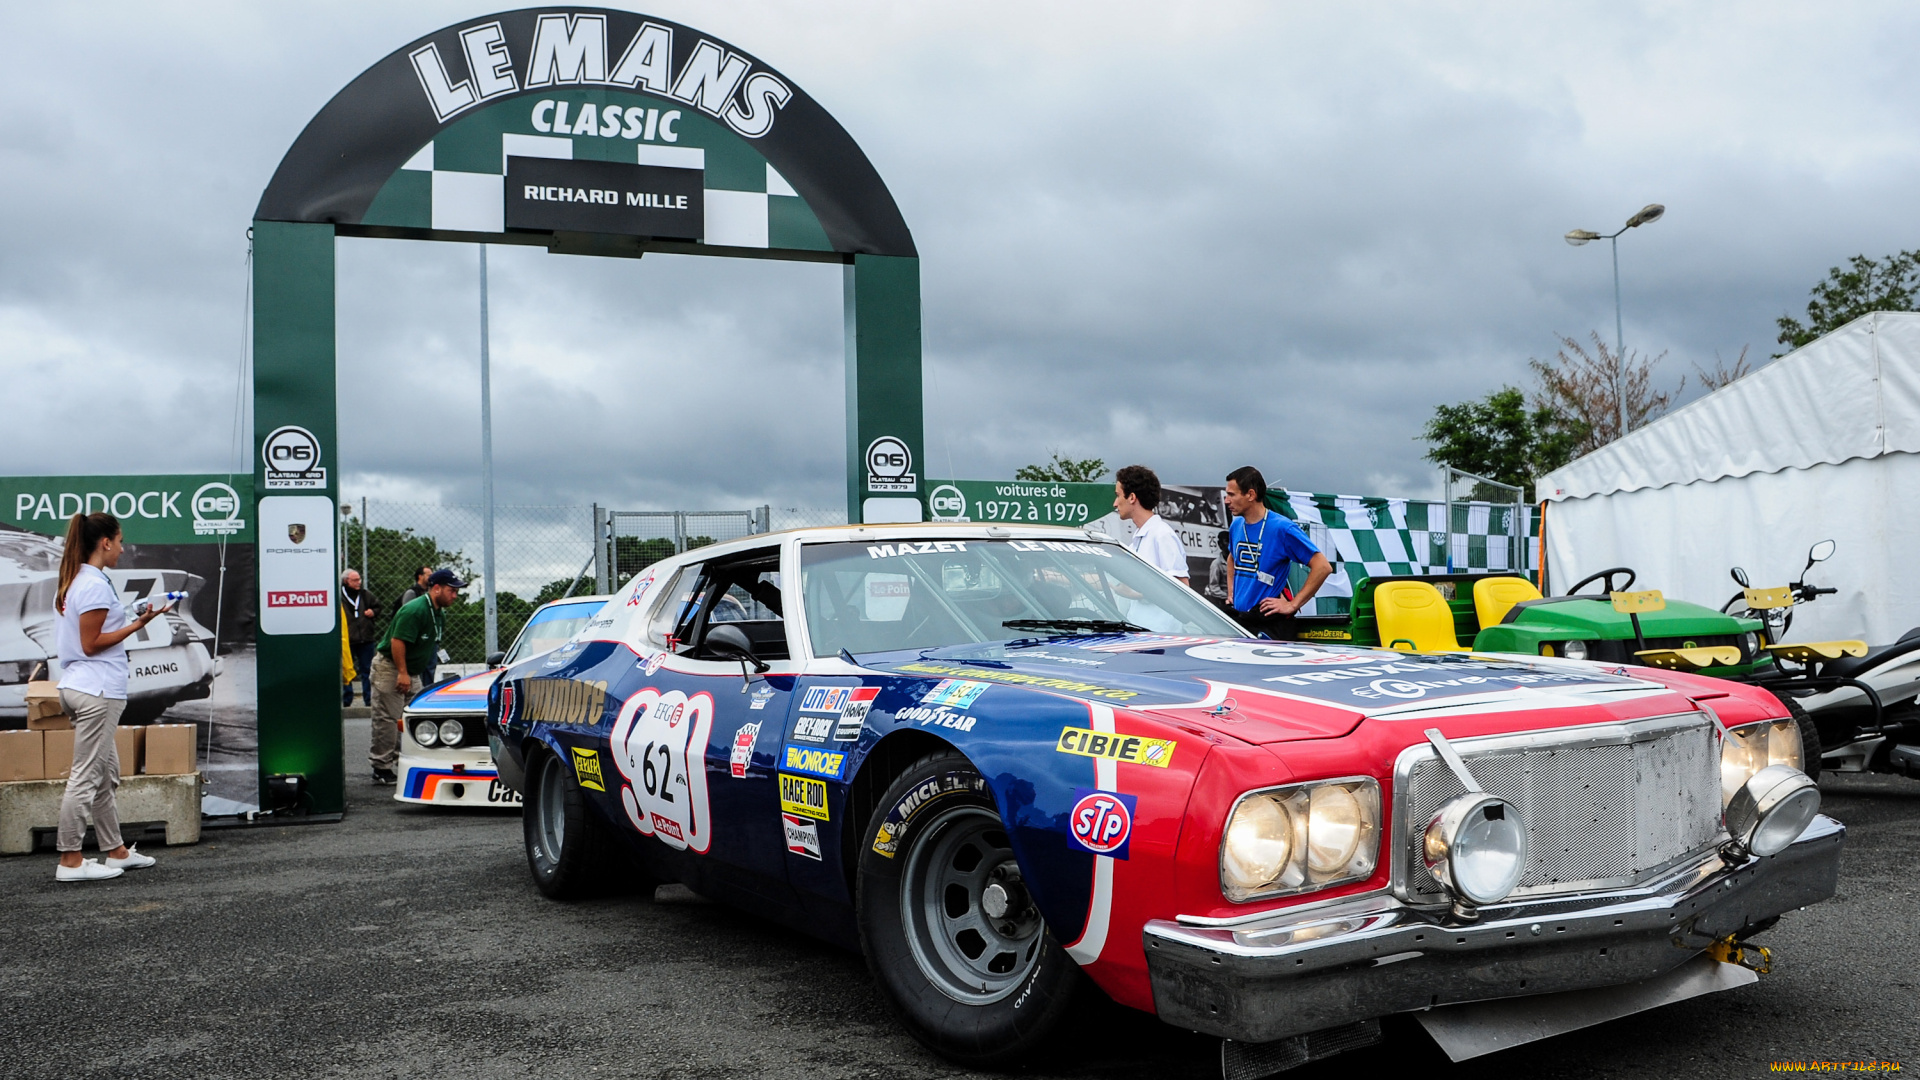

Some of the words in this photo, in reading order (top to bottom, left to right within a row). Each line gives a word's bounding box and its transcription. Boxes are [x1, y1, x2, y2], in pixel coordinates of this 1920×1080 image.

[408, 21, 520, 123] LE
[525, 13, 793, 137] MANS
[531, 99, 681, 143] CLASSIC
[523, 184, 619, 206] RICHARD
[626, 192, 688, 210] MILLE
[273, 445, 311, 460] 06
[873, 453, 904, 467] 06
[995, 483, 1047, 498] voitures
[1050, 484, 1066, 498] de
[15, 491, 183, 521] PADDOCK
[198, 497, 234, 513] 06
[934, 497, 962, 510] 06
[975, 500, 1023, 521] 1972
[1027, 501, 1039, 521] à
[1044, 502, 1089, 522] 1979
[866, 541, 967, 559] MAZET
[1006, 541, 1041, 552] LE
[1040, 541, 1113, 558] MANS
[887, 584, 910, 594] Poin
[271, 594, 287, 605] Le
[289, 592, 324, 605] Point
[1308, 630, 1325, 638] JOHN
[1323, 630, 1345, 638] DEERE
[136, 662, 178, 677] RACING
[802, 688, 850, 710] UNION
[940, 684, 983, 701] NASCAR
[653, 702, 674, 721] EFG
[843, 703, 868, 723] Holley
[629, 755, 636, 769] 6
[789, 748, 836, 775] MONROE
[642, 740, 674, 803] 62
[782, 777, 805, 804] RACE
[806, 781, 824, 808] ROD
[1075, 799, 1123, 843] STP
[786, 826, 818, 847] CHAMPION
